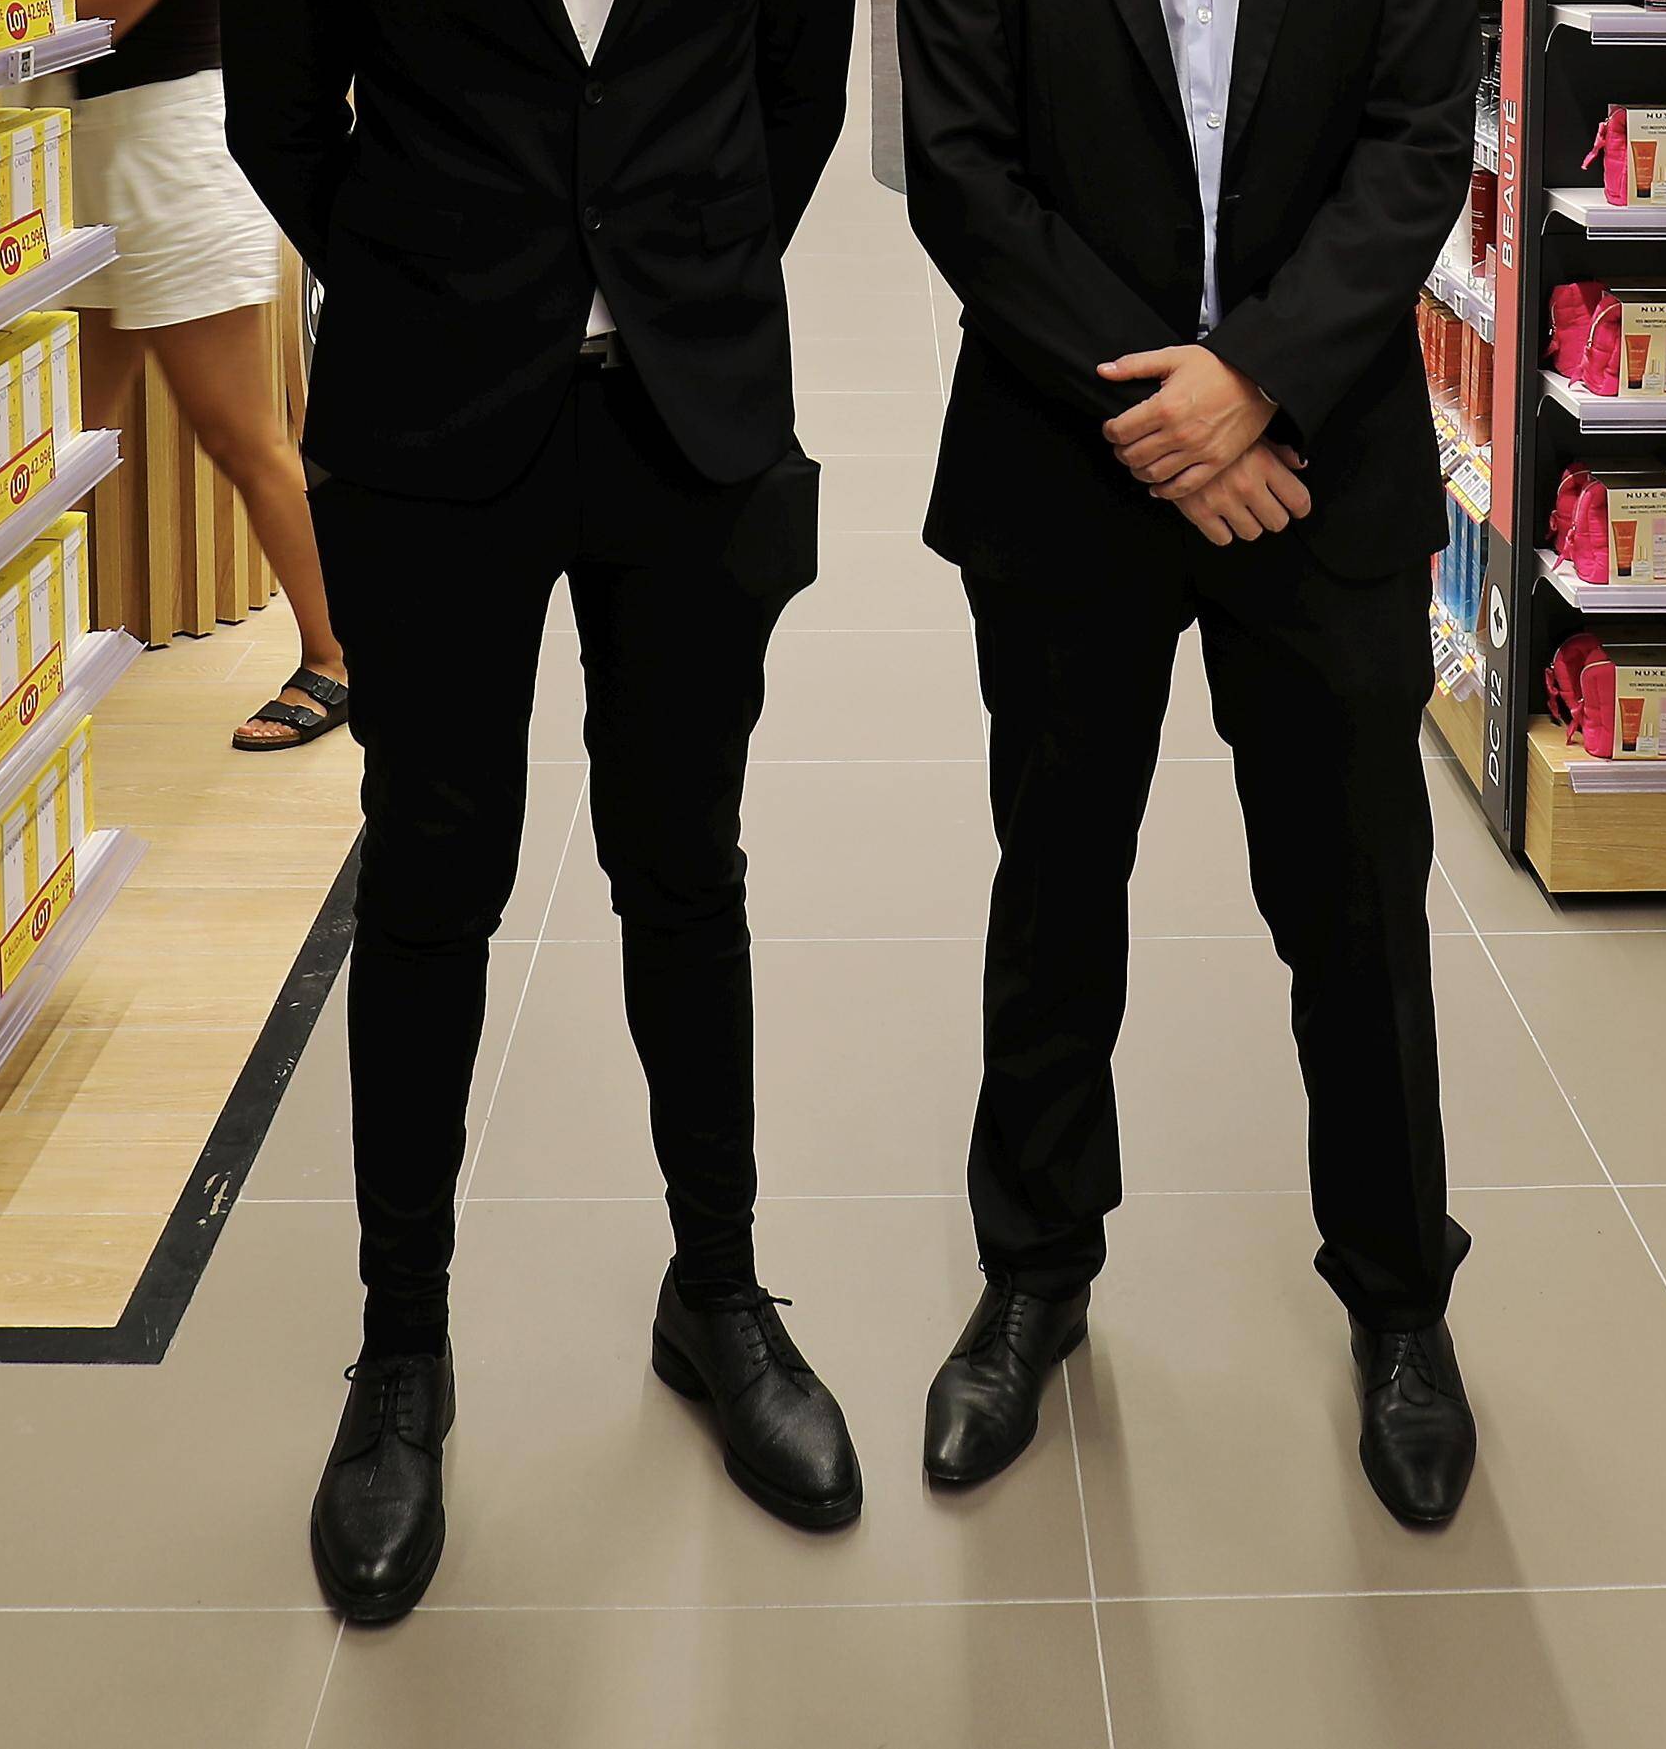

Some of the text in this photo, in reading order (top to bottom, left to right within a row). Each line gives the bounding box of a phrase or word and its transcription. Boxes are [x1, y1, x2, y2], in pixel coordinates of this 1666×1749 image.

[8, 10, 26, 32] LOT
[27, 0, 50, 20] 42.99€
[1501, 98, 1518, 269] BEAUTÉ
[1, 242, 20, 269] LOT
[21, 226, 45, 253] 42.99€
[12, 469, 30, 498] LOT
[31, 445, 52, 475] 42.99€
[20, 685, 40, 722] LOT
[39, 660, 62, 694] 42.99€
[1488, 669, 1504, 787] DC 12
[4, 867, 74, 965] CAUDALIE LOT 42.99€
